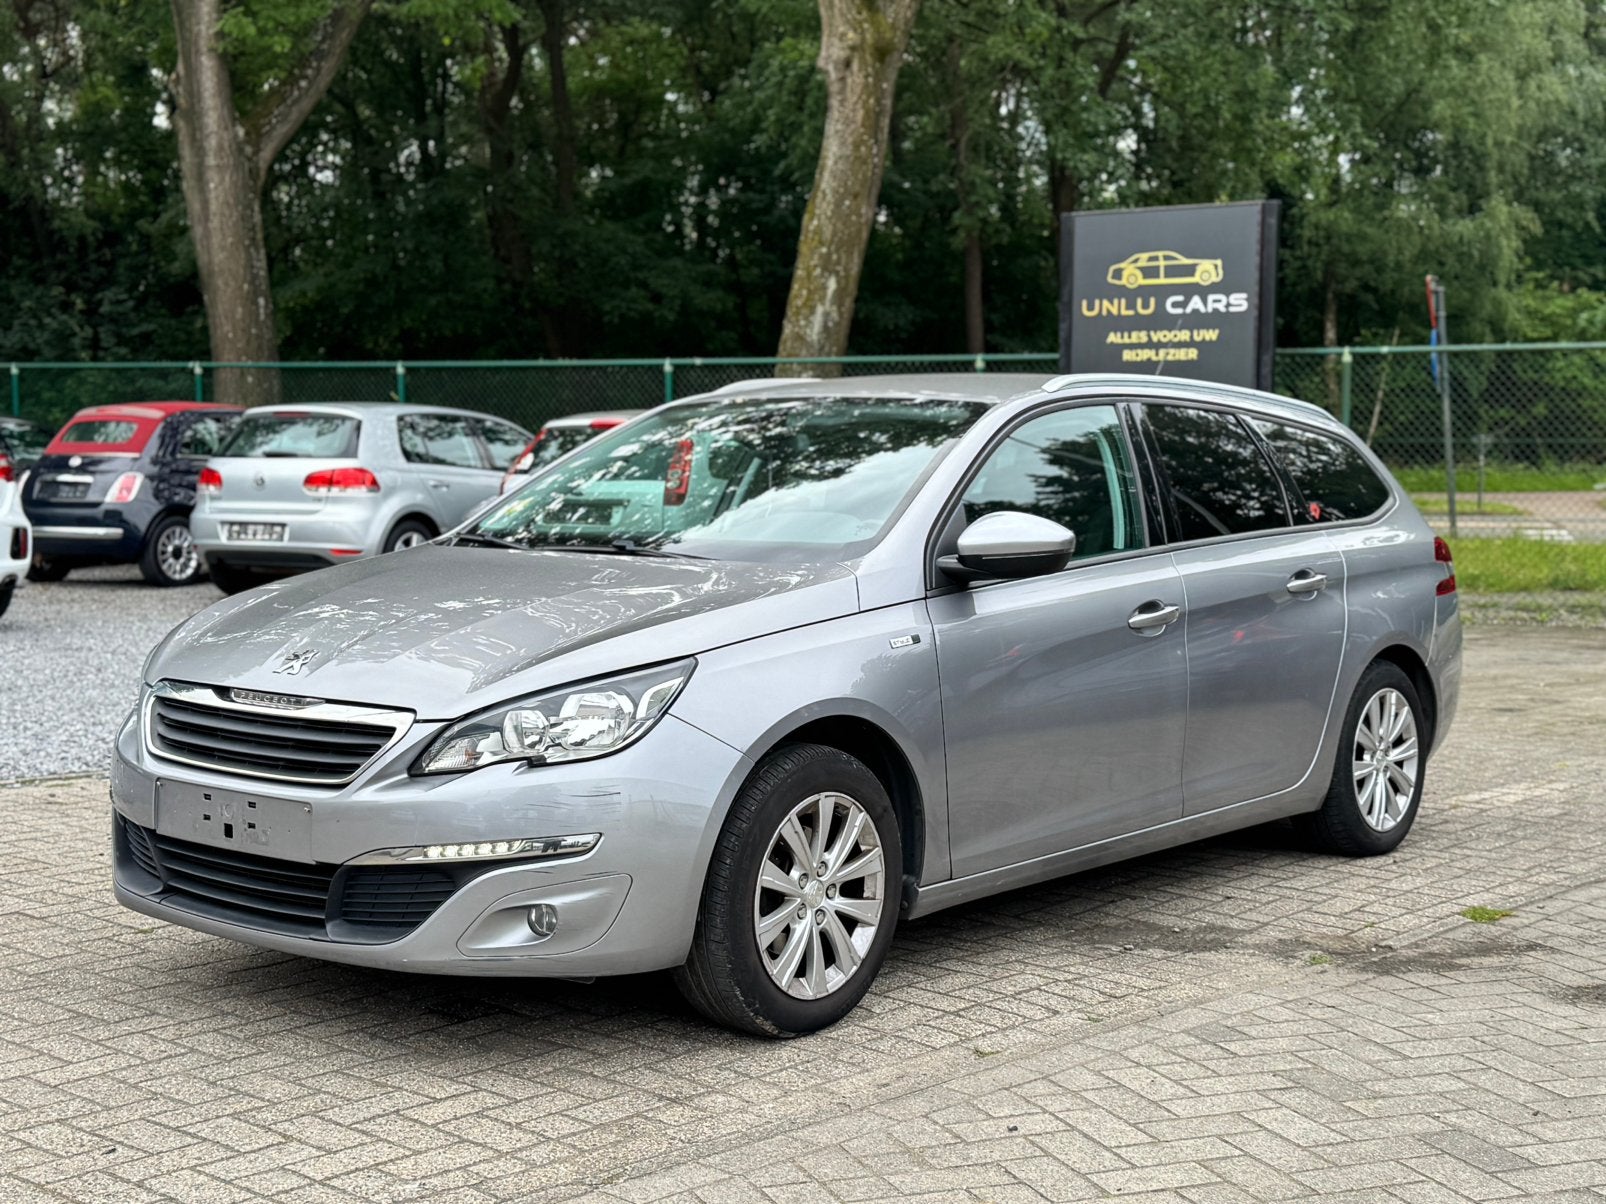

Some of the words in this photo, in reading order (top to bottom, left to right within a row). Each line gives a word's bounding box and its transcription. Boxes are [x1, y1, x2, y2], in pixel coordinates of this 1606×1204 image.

[1081, 297, 1156, 317] UNLU
[1165, 293, 1249, 315] CARS
[1106, 331, 1149, 344] ALLES
[1149, 329, 1191, 343] VOOR
[1193, 329, 1219, 342] UW
[1122, 348, 1198, 362] RIJPLEZIER
[240, 692, 297, 705] PEUGEOT
